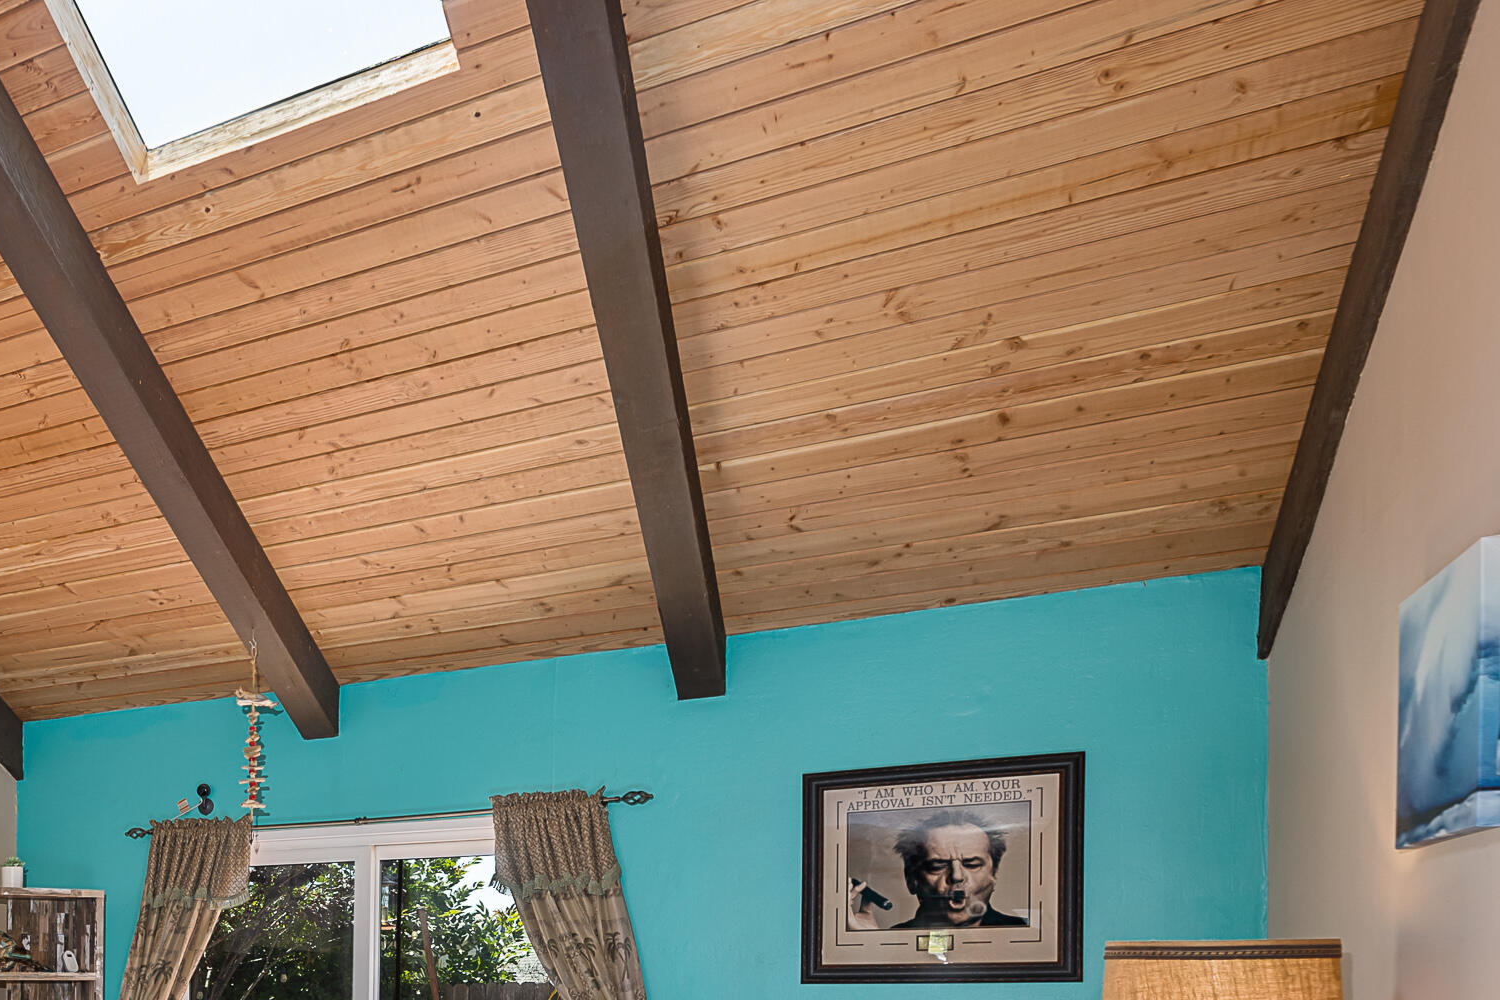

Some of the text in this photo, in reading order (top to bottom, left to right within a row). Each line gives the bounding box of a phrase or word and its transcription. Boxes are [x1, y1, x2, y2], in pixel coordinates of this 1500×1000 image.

[875, 788, 894, 798] AM
[903, 785, 933, 796] WHO
[941, 784, 946, 793] I
[954, 782, 978, 793] AM.
[982, 779, 1021, 791] YOUR
[847, 798, 914, 811] APPROVAL
[922, 794, 956, 807] ISN'T
